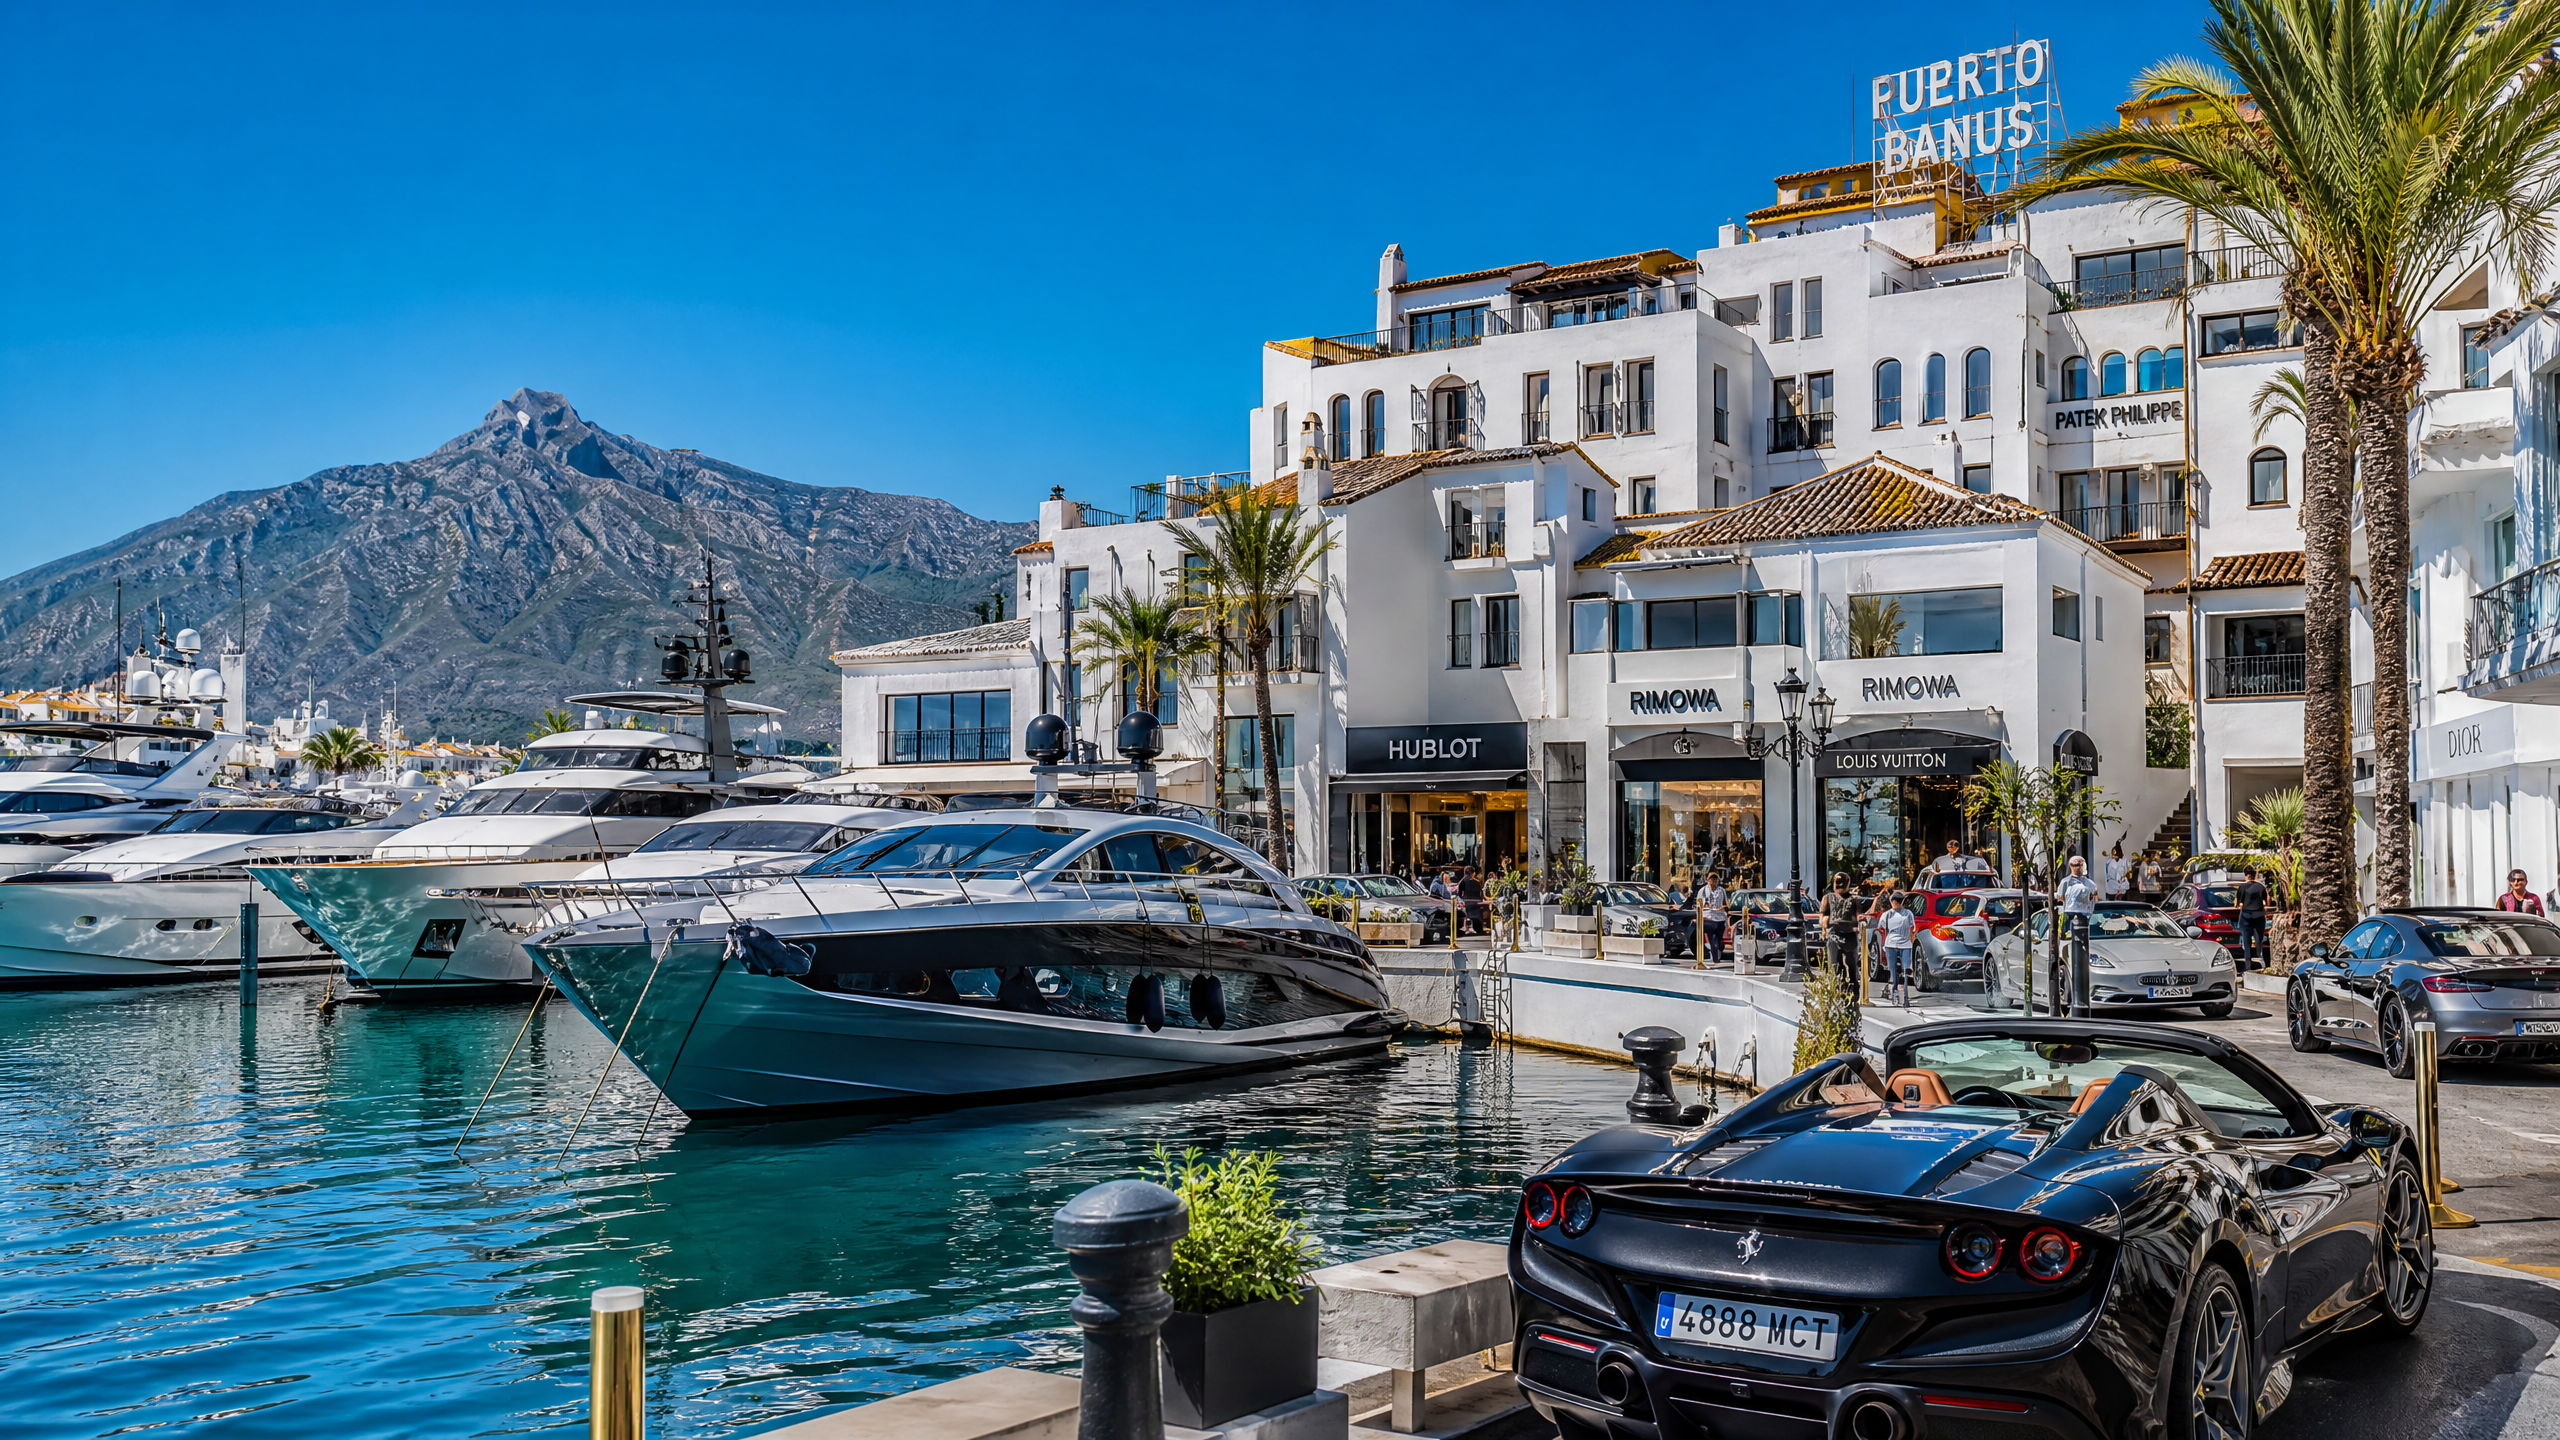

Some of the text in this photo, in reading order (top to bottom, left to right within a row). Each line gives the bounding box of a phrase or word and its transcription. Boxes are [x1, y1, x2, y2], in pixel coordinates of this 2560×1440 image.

[1872, 39, 2044, 120] PUERTO
[1884, 101, 2034, 175] BANUS
[2055, 400, 2184, 430] PATEK PHILIPPE
[1630, 688, 1723, 715] RIMOWA
[1862, 675, 1961, 702] RIMOWA
[1389, 738, 1482, 760] HUBLOT
[2448, 723, 2483, 758] DIOR
[1836, 752, 1946, 769] LOUIS VUITTON
[1678, 1301, 1830, 1351] 4888 MCT
